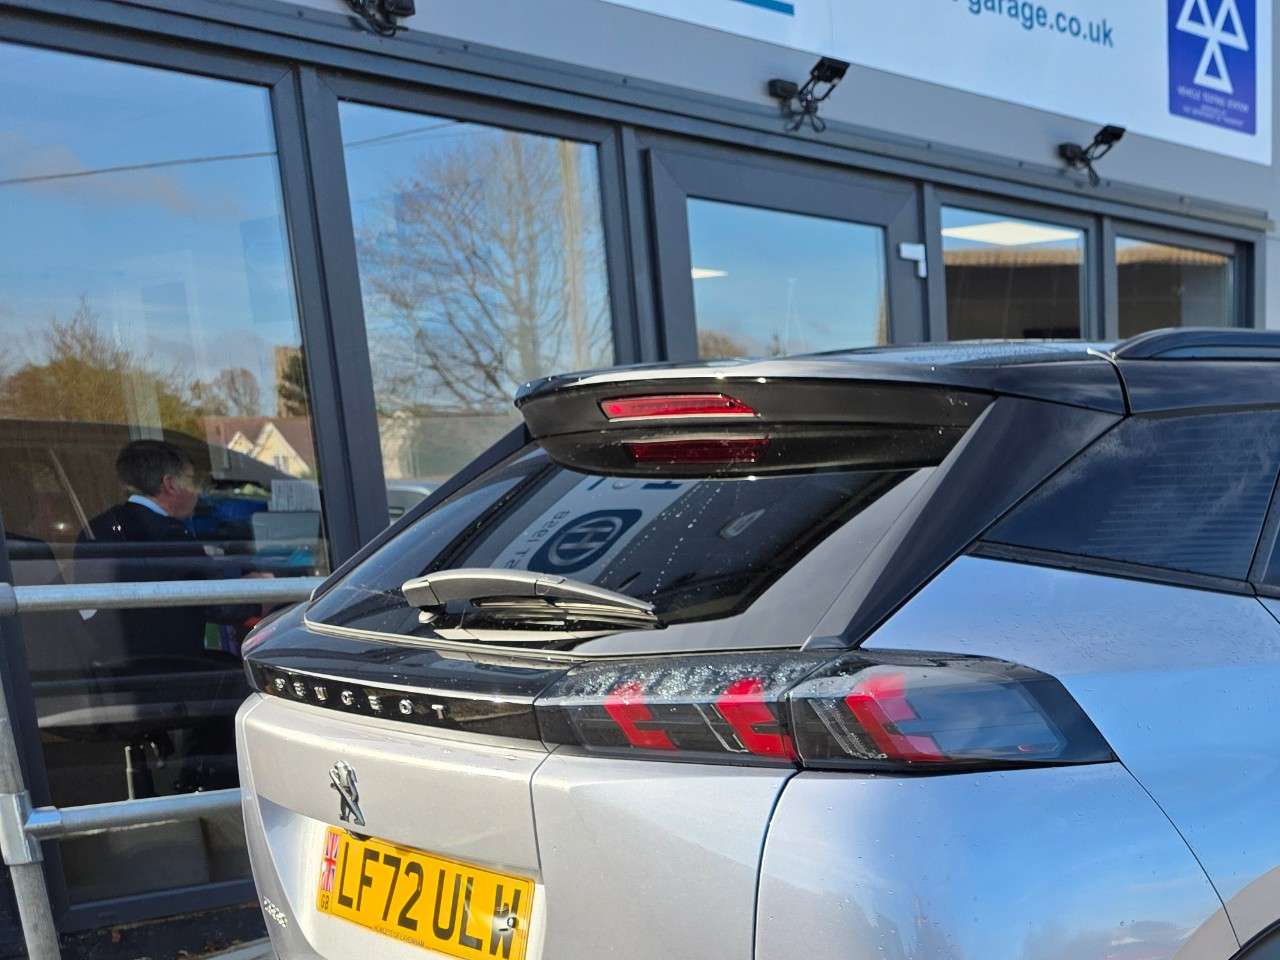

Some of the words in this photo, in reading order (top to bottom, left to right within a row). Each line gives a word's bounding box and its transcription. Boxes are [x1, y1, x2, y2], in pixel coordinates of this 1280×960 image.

[953, 0, 1114, 48] garage.co.uk
[273, 677, 446, 720] PEUGEOT
[320, 893, 330, 911] GB
[337, 841, 425, 931] LF72
[432, 869, 522, 960] ULW
